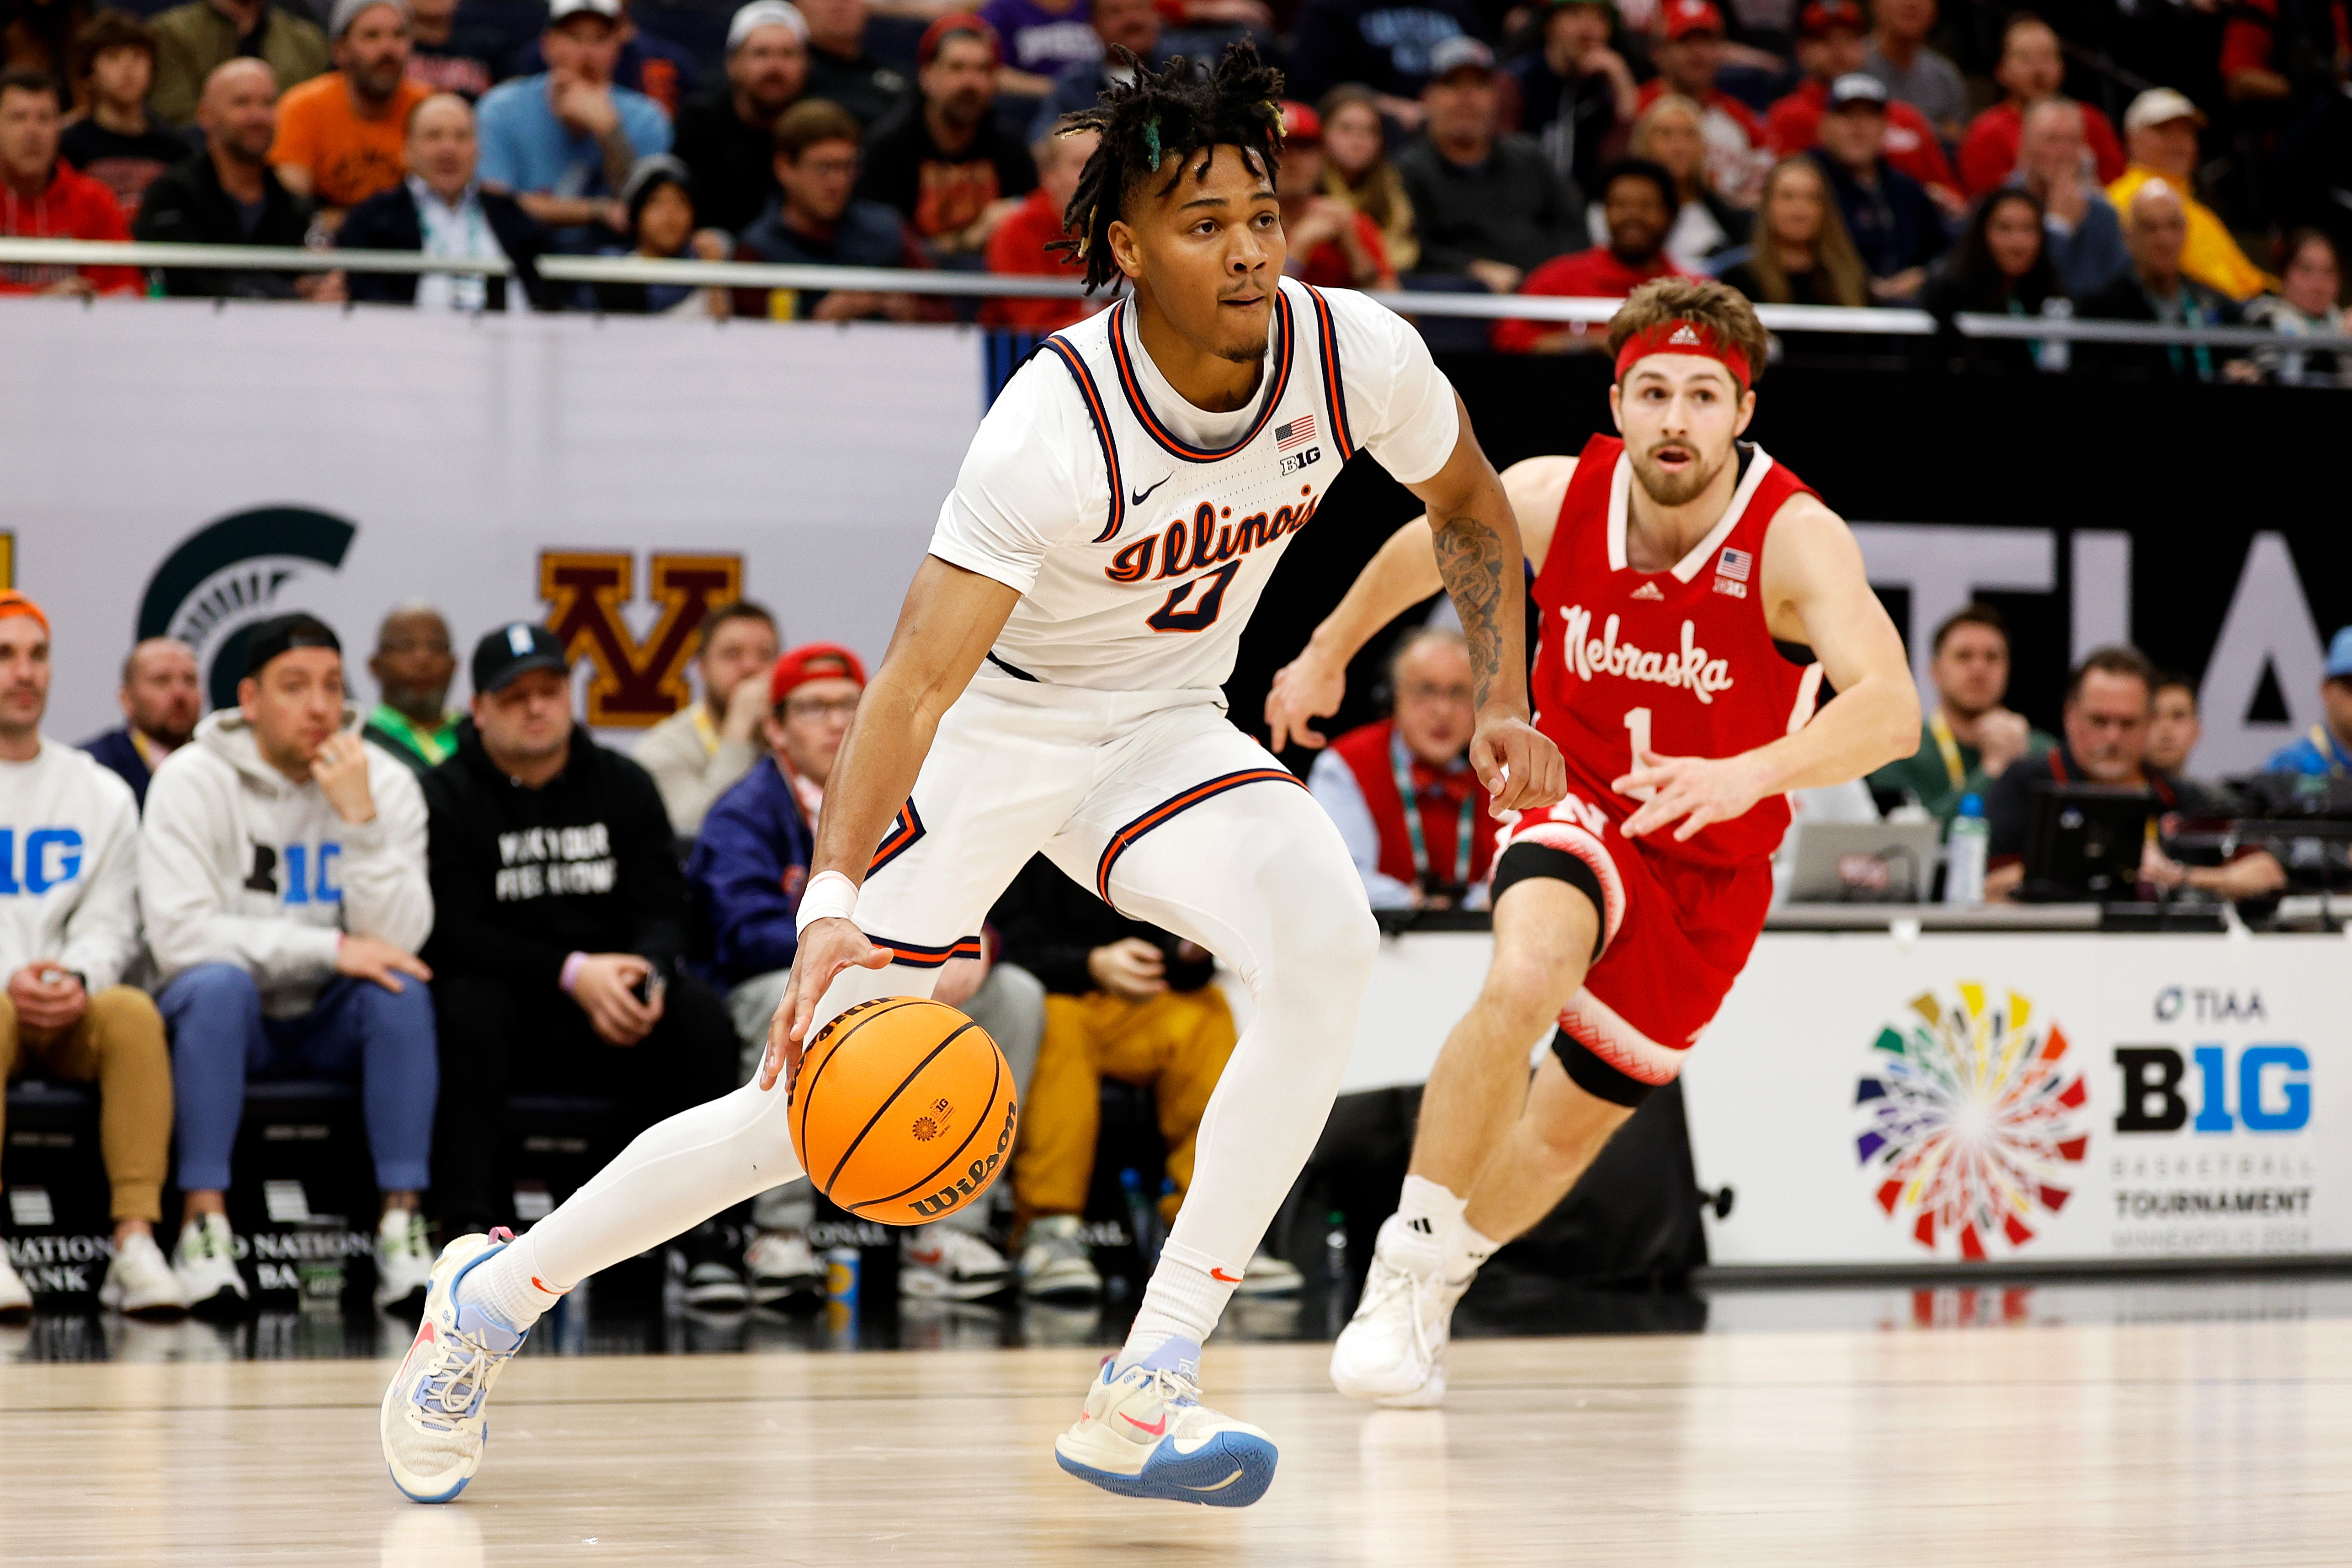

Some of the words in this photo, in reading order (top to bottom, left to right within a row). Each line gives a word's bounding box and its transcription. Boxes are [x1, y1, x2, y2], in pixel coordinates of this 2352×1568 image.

[1105, 484, 1319, 583] Illinois
[1559, 604, 1734, 704] Nebraska
[1623, 706, 1659, 805] 1
[2193, 988, 2267, 1022] TIAA
[907, 1101, 1016, 1217] Wilson
[2114, 1187, 2314, 1219] TOURNAMENT
